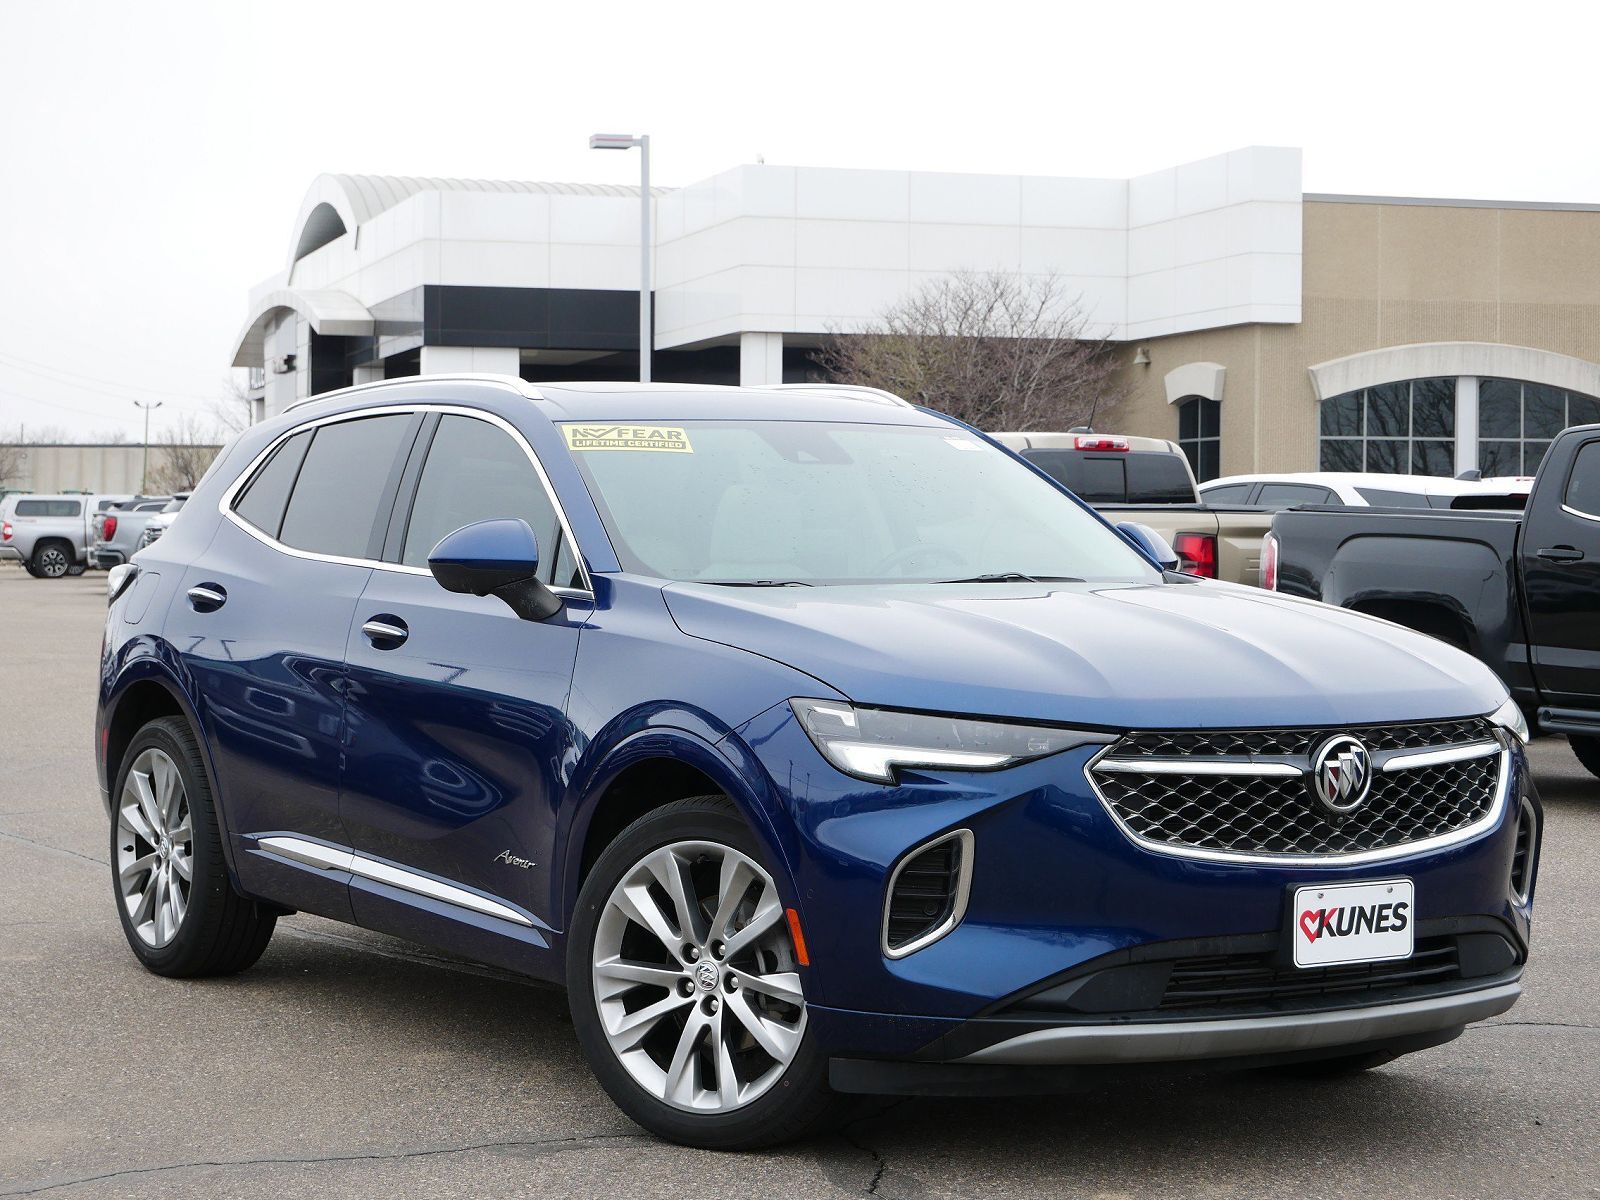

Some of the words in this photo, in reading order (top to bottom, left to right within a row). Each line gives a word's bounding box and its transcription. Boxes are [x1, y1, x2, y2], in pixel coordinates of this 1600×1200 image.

[617, 428, 683, 441] FEAR
[575, 439, 626, 448] LIFETIME
[627, 440, 684, 449] CERTIFIED
[1314, 901, 1409, 939] KUNES
